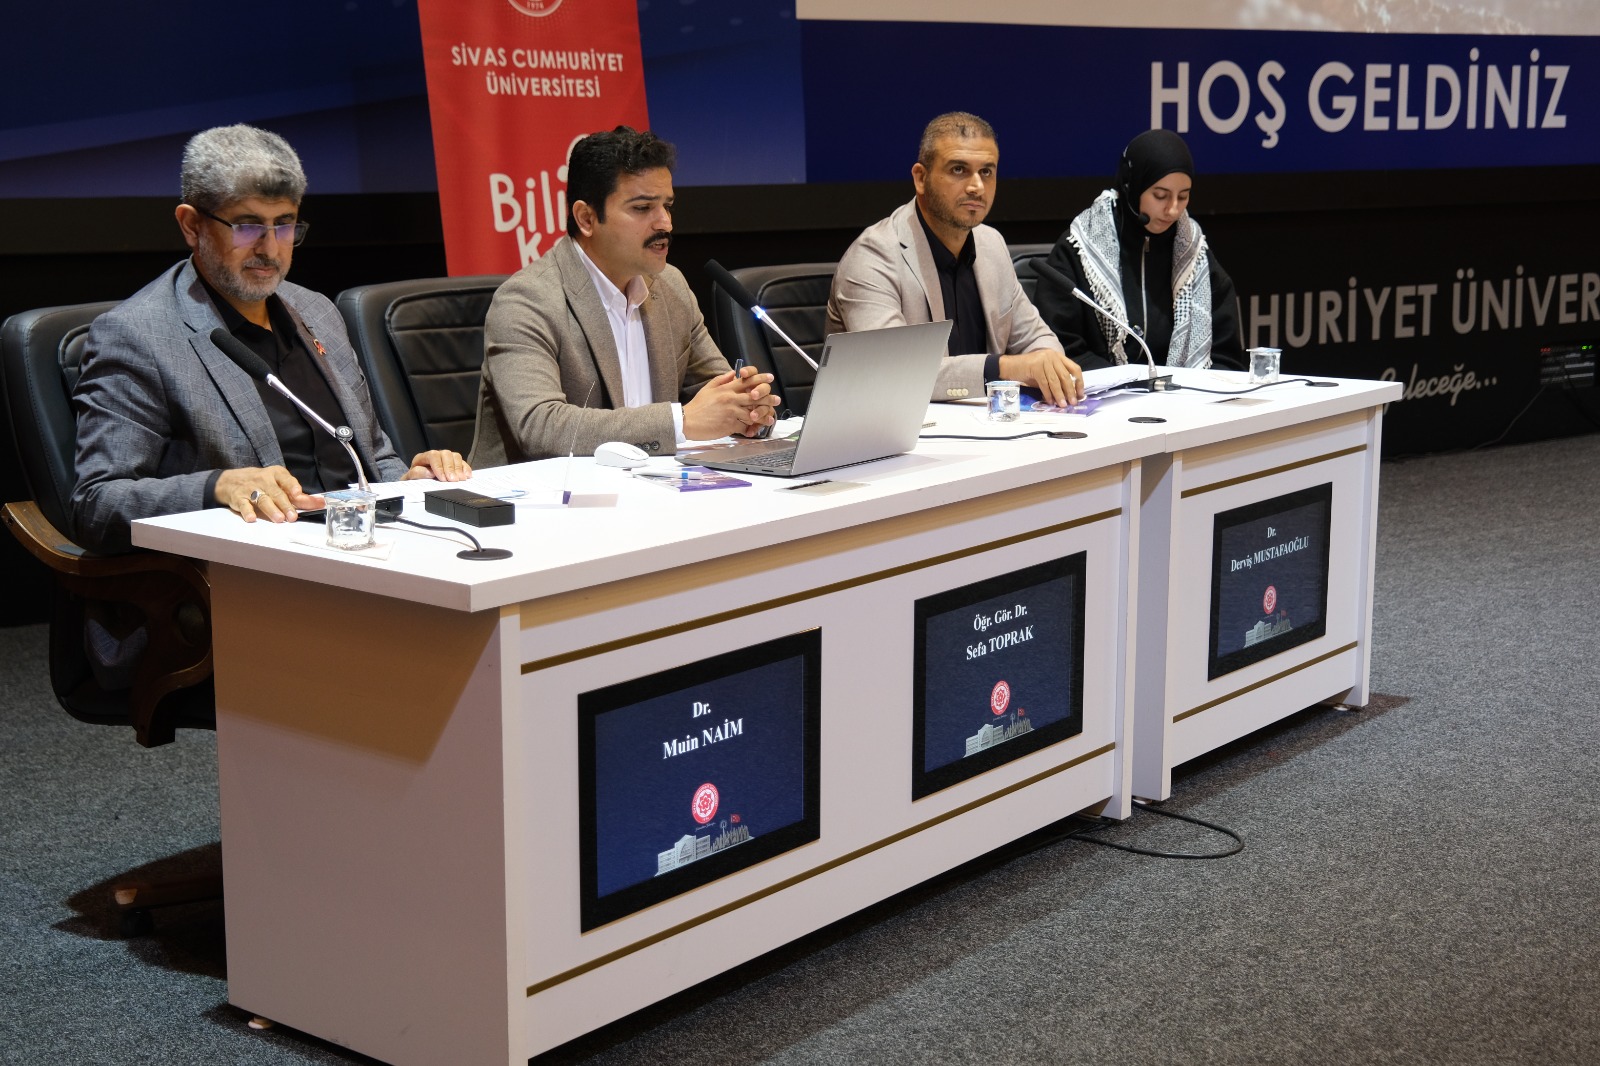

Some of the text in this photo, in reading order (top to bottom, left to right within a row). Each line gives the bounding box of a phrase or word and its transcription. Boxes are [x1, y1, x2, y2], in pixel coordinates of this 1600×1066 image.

[451, 42, 624, 72] SİVAS CUMHURİYET
[485, 72, 601, 98] ÜNİVERSİTESİ
[1150, 47, 1571, 149] HOŞ GELDİNİZ
[1235, 264, 1600, 352] HURİYET ÜNİVER
[1380, 363, 1498, 416] leceğe...
[1266, 526, 1277, 538] Dr.
[1230, 536, 1309, 572] Derviş MUSTAFAOĞLU
[973, 604, 1028, 632] Öğr. Gör. Dr.
[966, 624, 1034, 660] Sefa TOPRAK
[692, 701, 711, 718] Dr.
[662, 717, 744, 760] Muin NAİM
